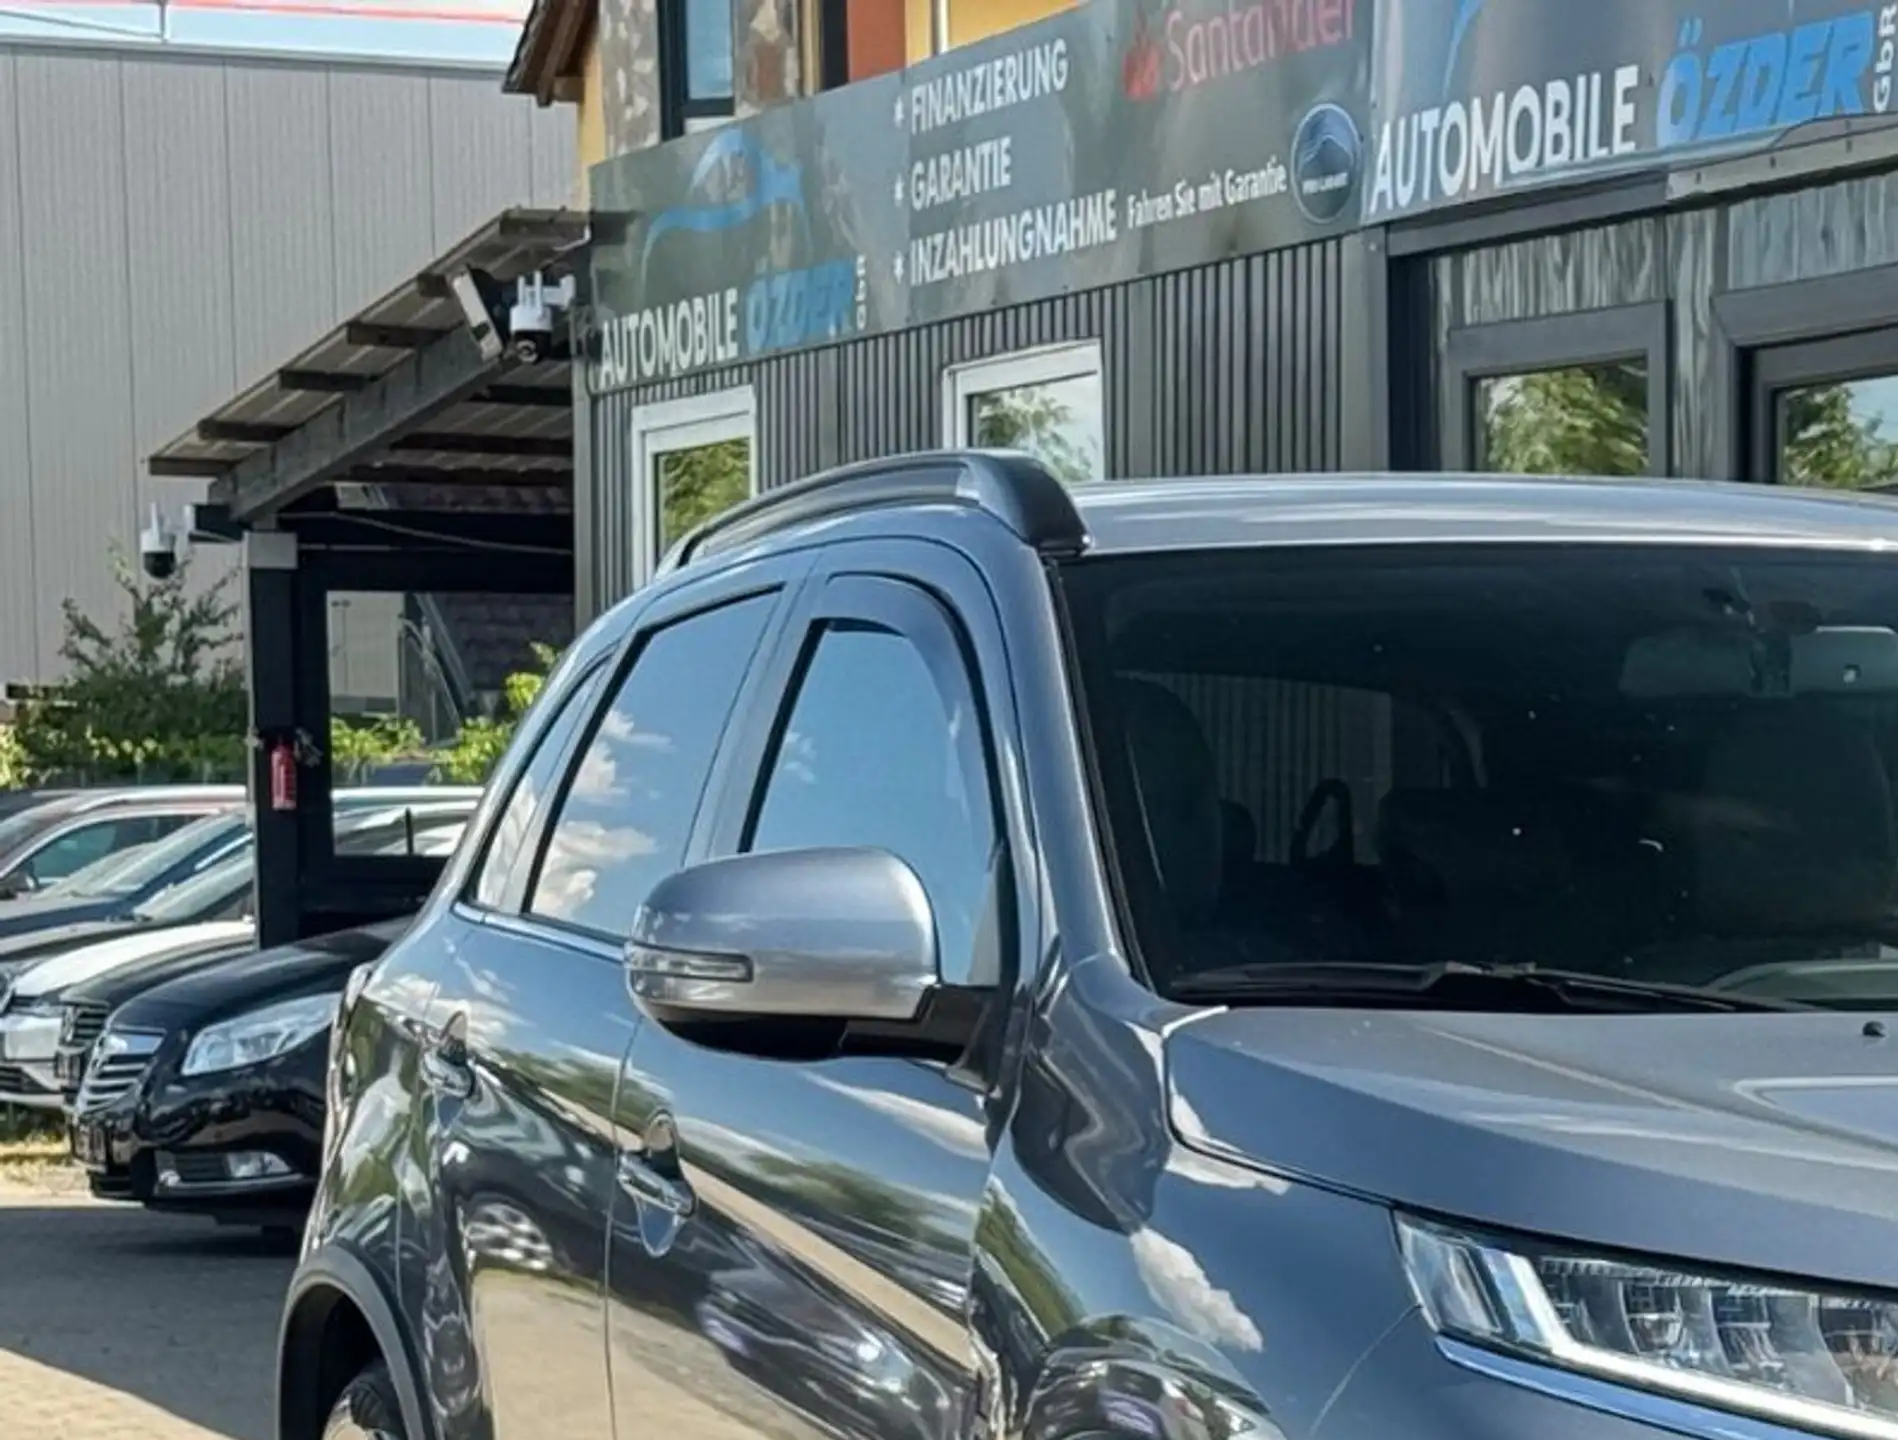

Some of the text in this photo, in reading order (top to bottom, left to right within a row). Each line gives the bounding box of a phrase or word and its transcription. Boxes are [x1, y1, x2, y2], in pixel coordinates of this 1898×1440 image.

[911, 38, 1068, 135] FINANZIERUNG
[1165, 0, 1354, 91] Santander
[1370, 3, 1898, 213] AUTOMOBILE ÖZDER GbR
[911, 136, 1011, 211] GARANTIE
[1127, 189, 1173, 229] Fahren
[1174, 178, 1196, 217] Sie
[1198, 170, 1223, 212] mit
[1224, 155, 1287, 205] Garantie
[910, 188, 1117, 286] INZAHLUNGNAHME
[600, 288, 738, 389] AUTOMOBILE
